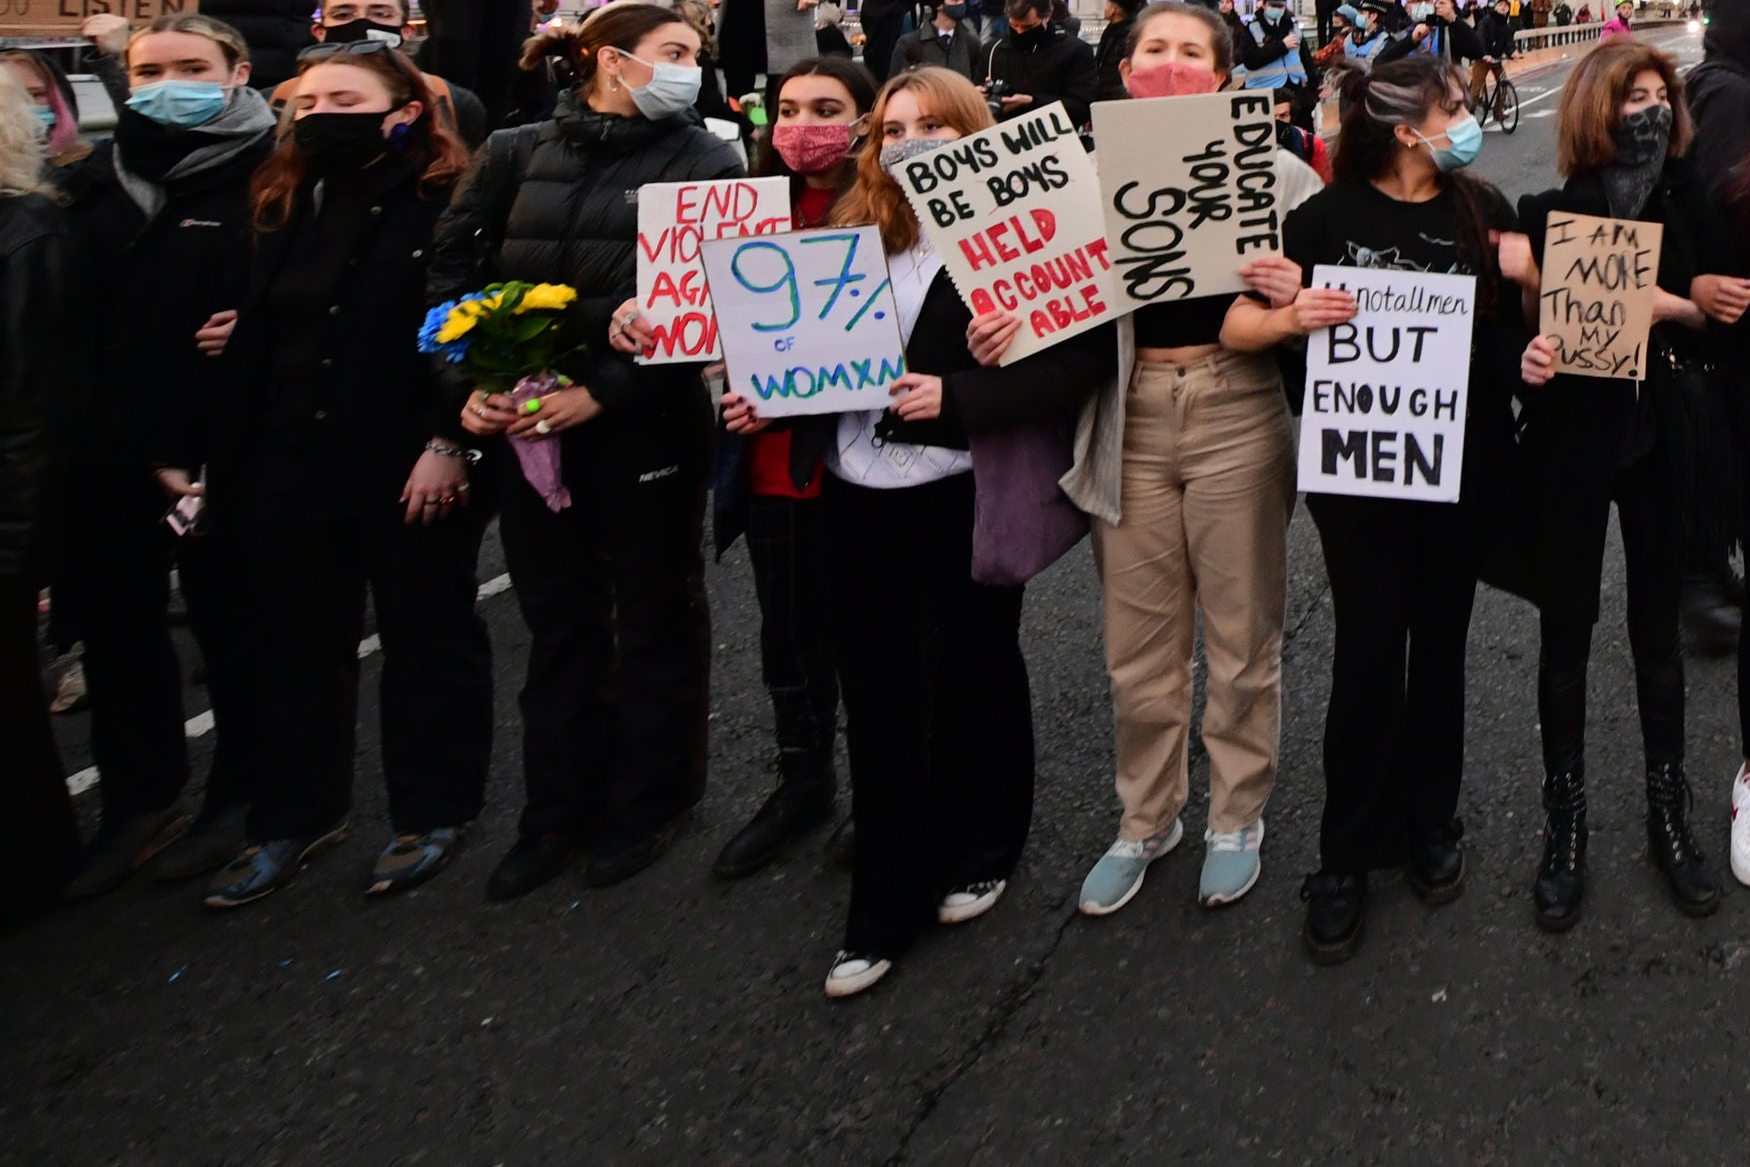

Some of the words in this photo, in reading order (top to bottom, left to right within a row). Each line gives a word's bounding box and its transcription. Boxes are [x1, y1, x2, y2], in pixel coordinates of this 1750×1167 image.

[905, 137, 999, 195] BOYS
[1001, 112, 1073, 155] WILL
[1230, 96, 1280, 255] EDUCATE
[676, 182, 758, 224] END
[926, 190, 976, 229] BE
[986, 155, 1070, 208] BOYS
[1182, 139, 1233, 231] YOUR
[958, 208, 1057, 272] HELD
[1113, 181, 1195, 301] SONS
[1546, 218, 1577, 247] I
[1588, 222, 1639, 250] AM
[730, 232, 891, 333] 97%
[970, 236, 1112, 317] ACCOUNT
[1564, 248, 1653, 291] MORE
[1029, 283, 1107, 339] ABLE
[1324, 282, 1469, 316] notallmen
[774, 336, 796, 352] OF
[1327, 321, 1439, 365] BUT
[1579, 325, 1622, 351] MY
[750, 354, 905, 401] WOMXN
[1312, 379, 1459, 422] ENOUGH
[1320, 427, 1445, 487] MEN
